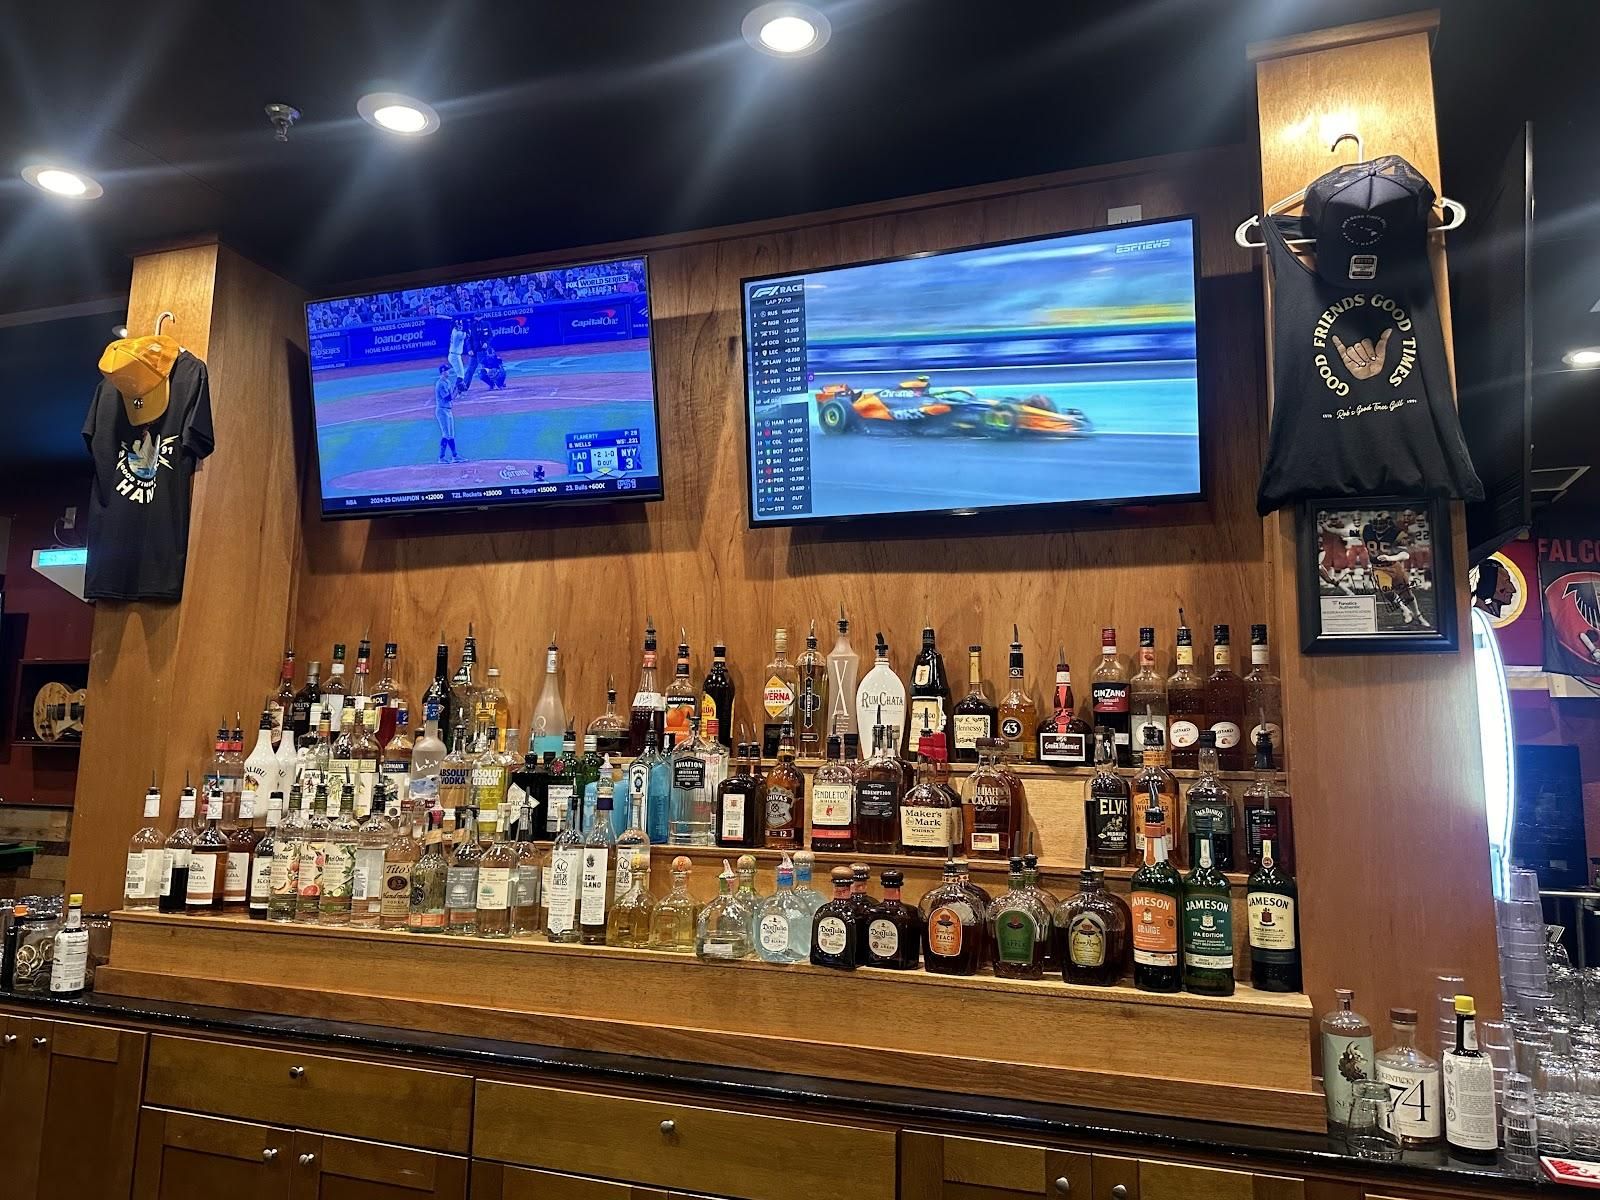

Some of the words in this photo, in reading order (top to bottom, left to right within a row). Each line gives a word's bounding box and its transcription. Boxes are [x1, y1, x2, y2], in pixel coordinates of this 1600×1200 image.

[1115, 239, 1171, 254] ESPNEWS
[580, 278, 602, 288] WORLD
[780, 284, 802, 294] RACE
[483, 308, 534, 318] NKEES.COM/2025
[1370, 294, 1412, 332] GOOD
[1314, 294, 1366, 348] FRIENDS
[374, 330, 424, 345] loanDepot
[365, 346, 382, 354] HOME
[382, 344, 402, 352] MEANS
[402, 340, 436, 350] EVERYTHING
[1389, 336, 1416, 388] TIMES
[1314, 354, 1350, 396] GOOD
[880, 390, 914, 398] Chrome
[1336, 406, 1356, 420] Rob's
[1356, 404, 1372, 416] Good
[1372, 402, 1388, 412] Times
[162, 446, 174, 454] 91
[621, 448, 637, 457] NYY
[572, 452, 587, 460] LAD
[576, 462, 584, 472] 0
[626, 458, 634, 469] 3
[120, 464, 135, 482] GOOD
[500, 467, 530, 480] Corona
[116, 479, 154, 504] HAN
[1415, 530, 1430, 541] 22
[1094, 688, 1126, 698] CINZANO
[534, 716, 547, 731] Q
[1003, 722, 1018, 734] 43
[957, 725, 982, 733] Hennessy
[814, 789, 849, 799] PENDLETON
[972, 796, 999, 806] CRAIG
[905, 809, 942, 818] Maker's
[915, 818, 941, 826] Mark
[386, 864, 412, 874] Tito's
[1132, 896, 1170, 911] JAMESON
[1186, 900, 1229, 912] JAMESON
[1249, 896, 1289, 910] JAMESON
[762, 923, 774, 932] Don
[831, 926, 845, 935] Julio
[1138, 925, 1160, 934] ORANGE
[882, 929, 896, 938] Julio
[1381, 1073, 1416, 1085] KENTUCKY
